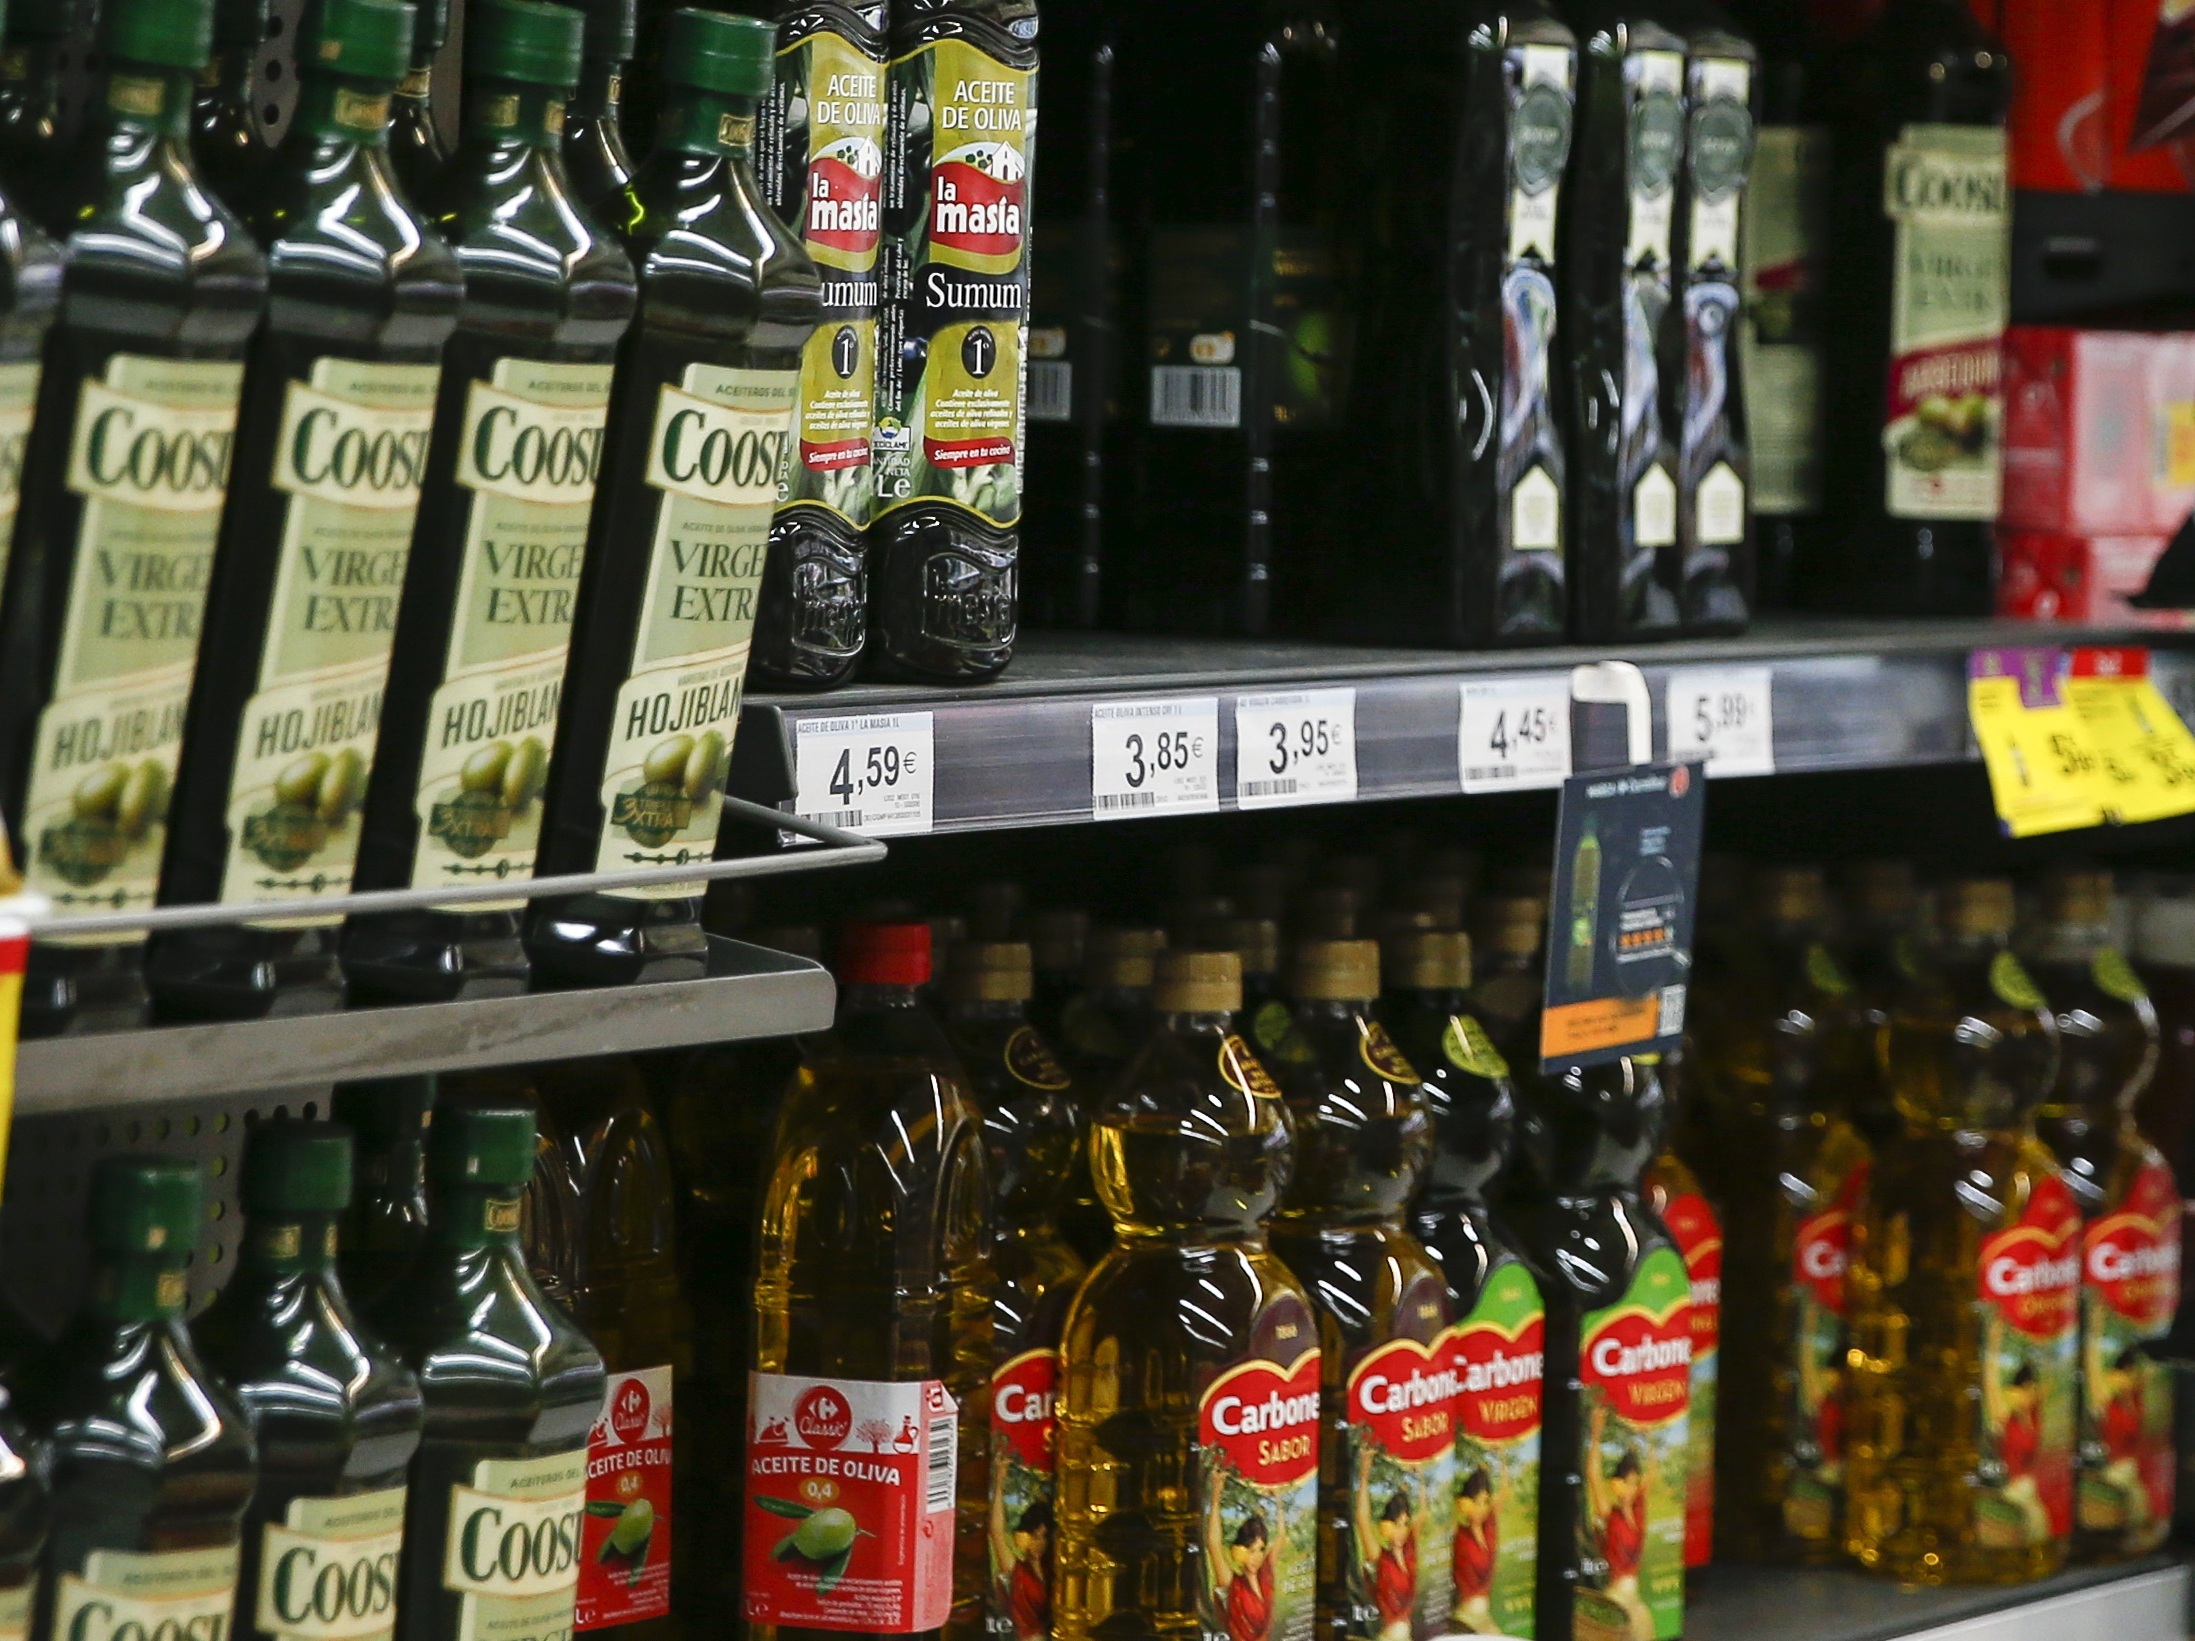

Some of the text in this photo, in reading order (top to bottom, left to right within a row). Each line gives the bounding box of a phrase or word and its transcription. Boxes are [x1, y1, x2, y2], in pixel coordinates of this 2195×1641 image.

[827, 75, 876, 98] ACEITE
[953, 80, 1015, 105] ACEITE
[817, 102, 881, 125] DE OLIVA
[942, 107, 1021, 131] DE OLIVA
[812, 173, 829, 198] la
[938, 177, 956, 200] la
[821, 282, 877, 306] umum
[926, 273, 1021, 307] Sumum
[934, 444, 1011, 460] Siempre en tu cocina
[1125, 731, 1204, 787] 3,85€
[1269, 720, 1342, 774] 3,95€
[829, 745, 918, 805] 4,59€
[588, 1452, 625, 1478] CEITE
[626, 1449, 643, 1467] DE
[752, 1456, 901, 1487] ACEITE DE OLIVA
[807, 1481, 833, 1501] 0,4
